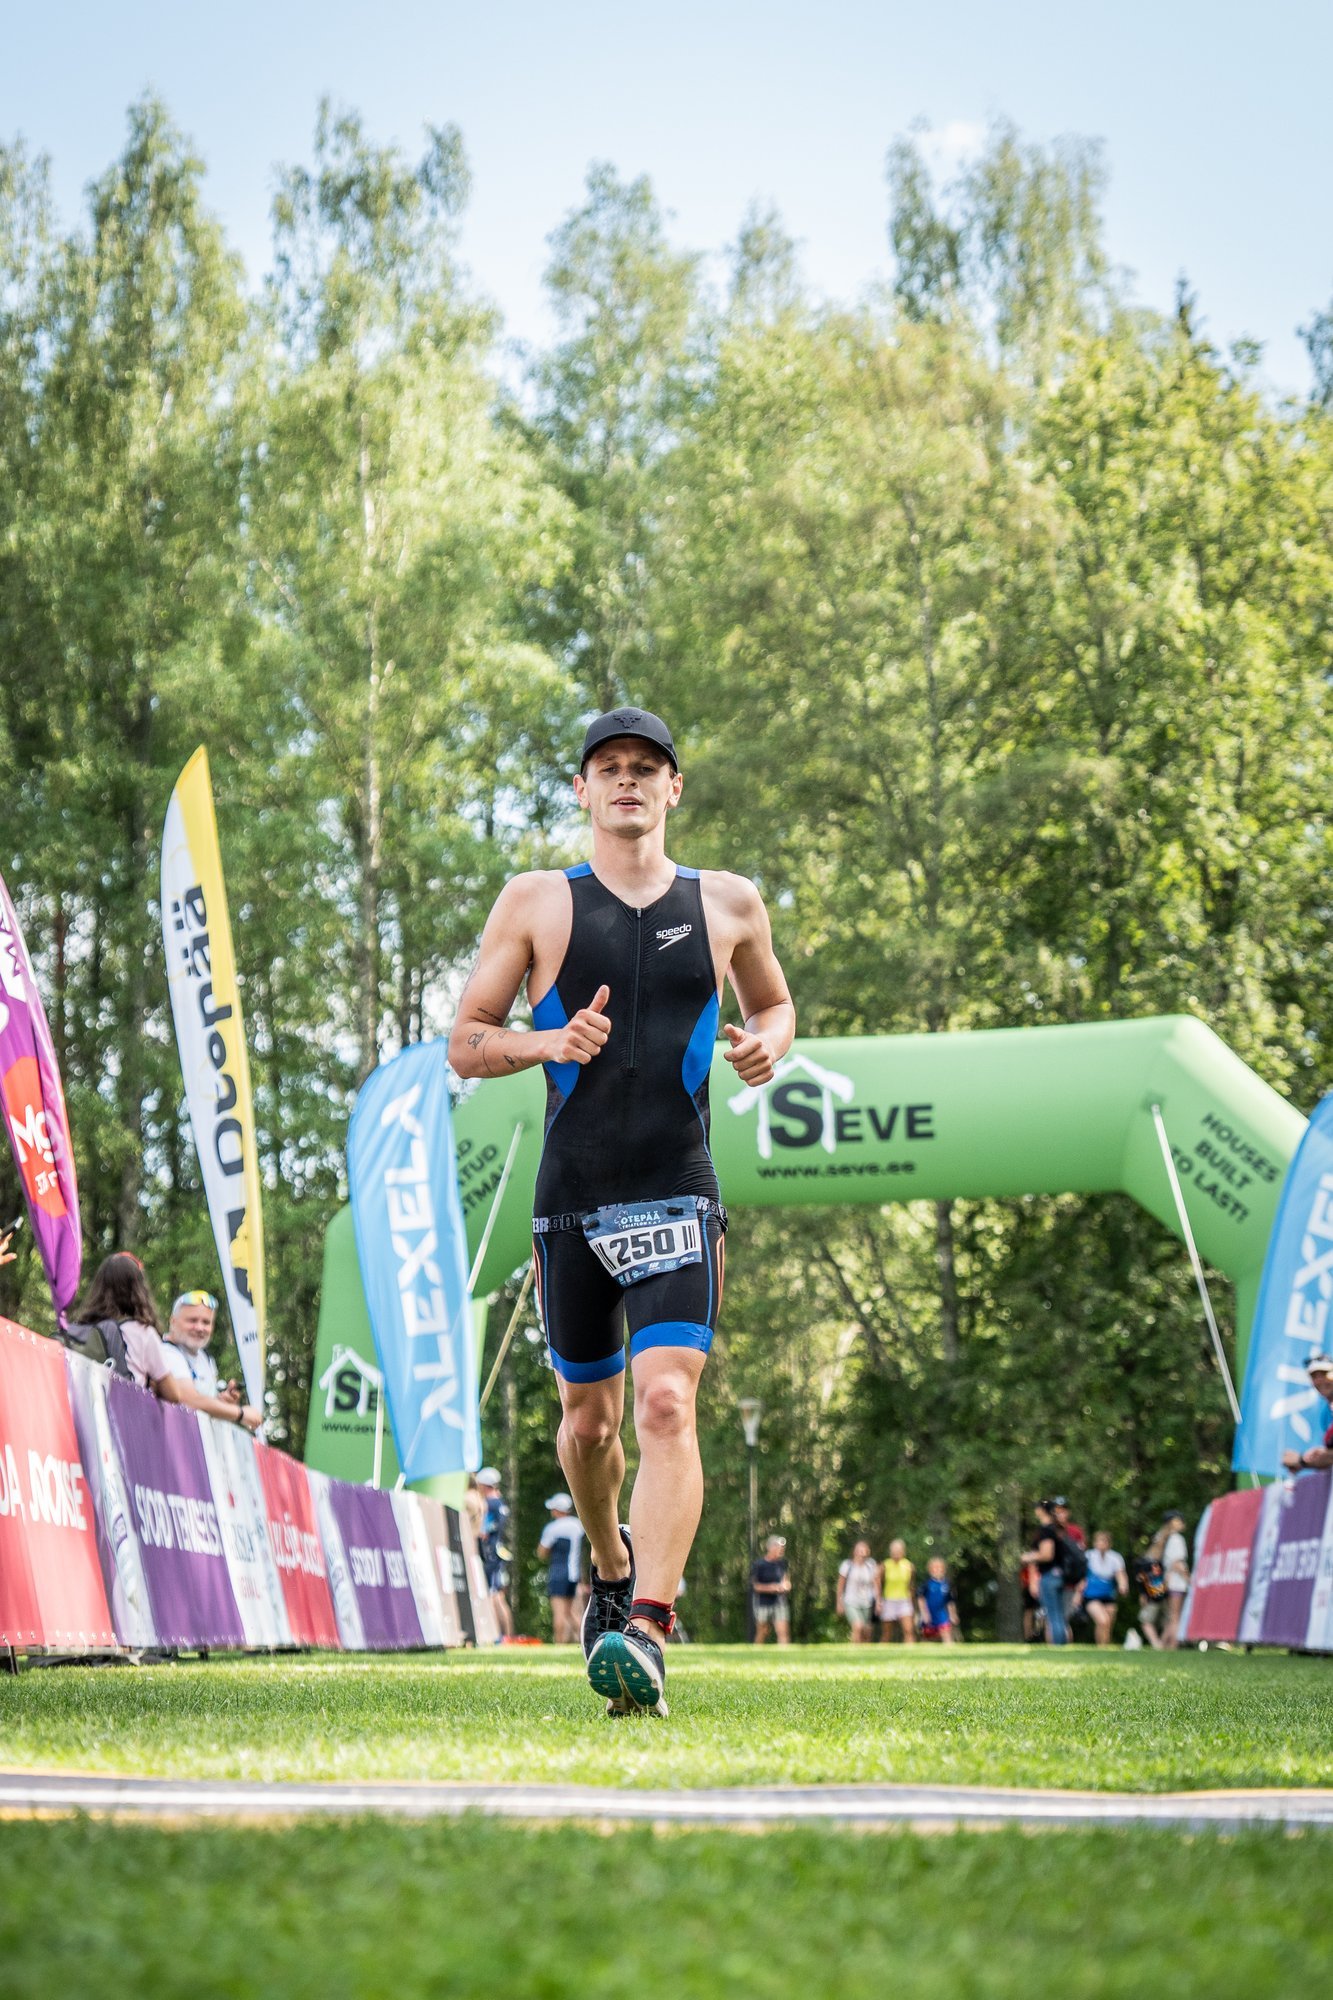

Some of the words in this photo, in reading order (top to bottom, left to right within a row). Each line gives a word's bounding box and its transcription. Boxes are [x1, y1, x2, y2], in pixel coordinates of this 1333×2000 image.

[656, 924, 692, 939] speedo
[1171, 1145, 1194, 1174] TO
[1202, 1113, 1280, 1182] HOUSES
[757, 1162, 916, 1179] www.seve.ee
[1195, 1140, 1252, 1190] BUILT
[620, 1210, 661, 1224] OTEPÄÄ
[381, 1081, 466, 1430] ALEXELA
[609, 1228, 676, 1266] 250
